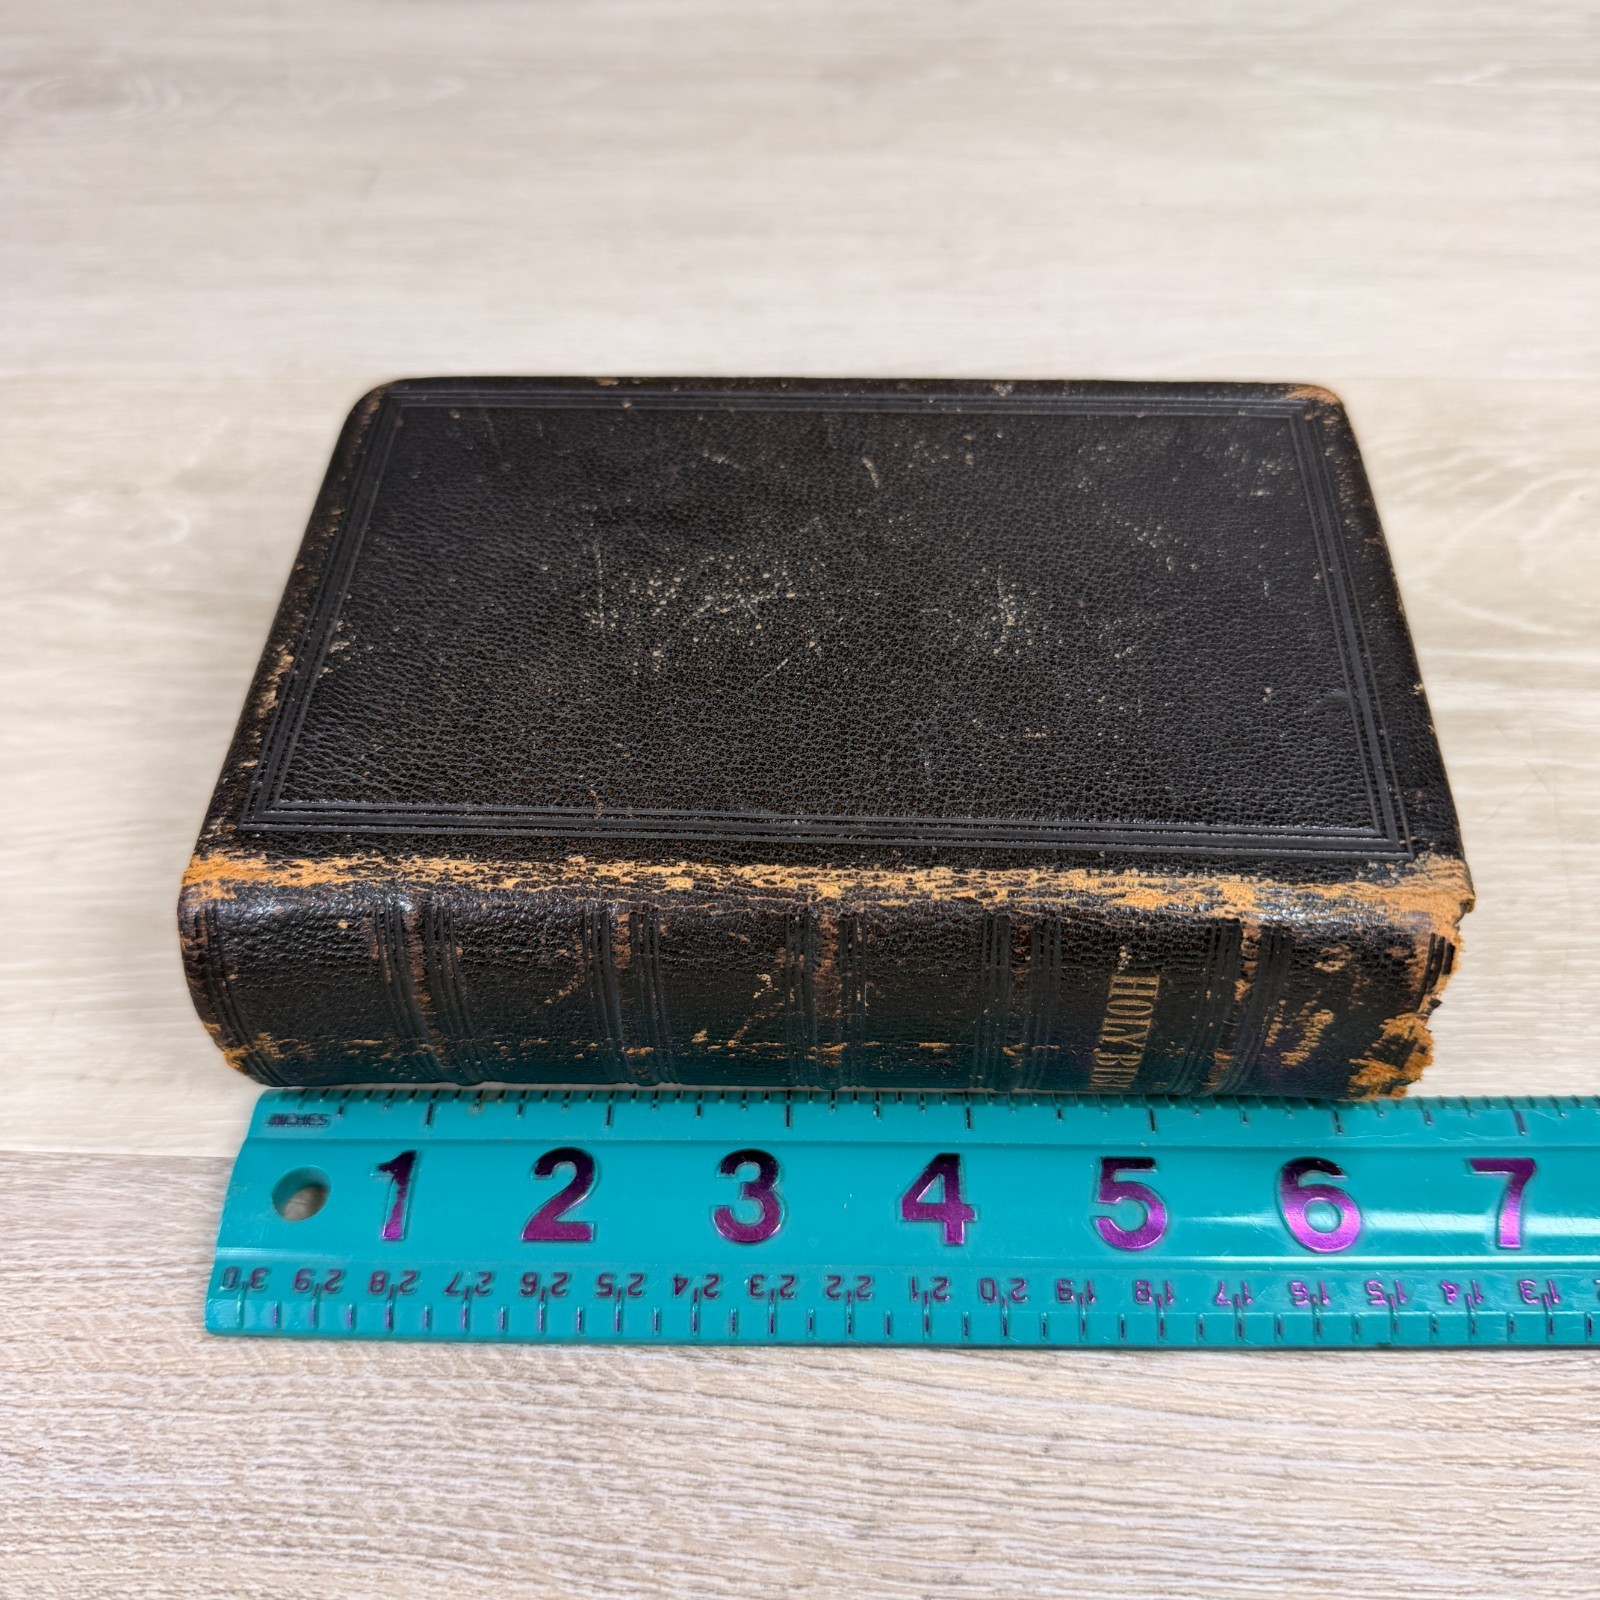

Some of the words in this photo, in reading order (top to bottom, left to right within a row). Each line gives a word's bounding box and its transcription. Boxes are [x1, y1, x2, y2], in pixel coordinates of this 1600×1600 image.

[1100, 971, 1160, 1050] HOLY
[1088, 1052, 1144, 1090] BIBL
[267, 1112, 330, 1127] INCHES
[369, 1148, 420, 1241] 1
[521, 1147, 597, 1243] 2
[711, 1148, 785, 1244] 3
[900, 1152, 978, 1246] 4
[1093, 1156, 1167, 1250] 5
[1276, 1156, 1362, 1253] 6
[1466, 1157, 1537, 1250] 7
[222, 1267, 268, 1291] 30
[293, 1268, 342, 1293] 29
[368, 1270, 419, 1295] 28
[444, 1271, 493, 1296] 27
[520, 1272, 569, 1297] 26
[596, 1273, 645, 1298] 25
[673, 1273, 721, 1299] 24
[748, 1273, 796, 1300] 23
[825, 1274, 873, 1300] 22
[910, 1276, 950, 1301] 21
[979, 1277, 1027, 1303] 20
[1055, 1279, 1096, 1304] 19
[1441, 1279, 1484, 1304] 14
[1518, 1279, 1561, 1304] 13
[1134, 1279, 1174, 1305] 18
[1212, 1280, 1252, 1306] 17
[1289, 1280, 1331, 1306] 16
[1365, 1279, 1407, 1306] 15
